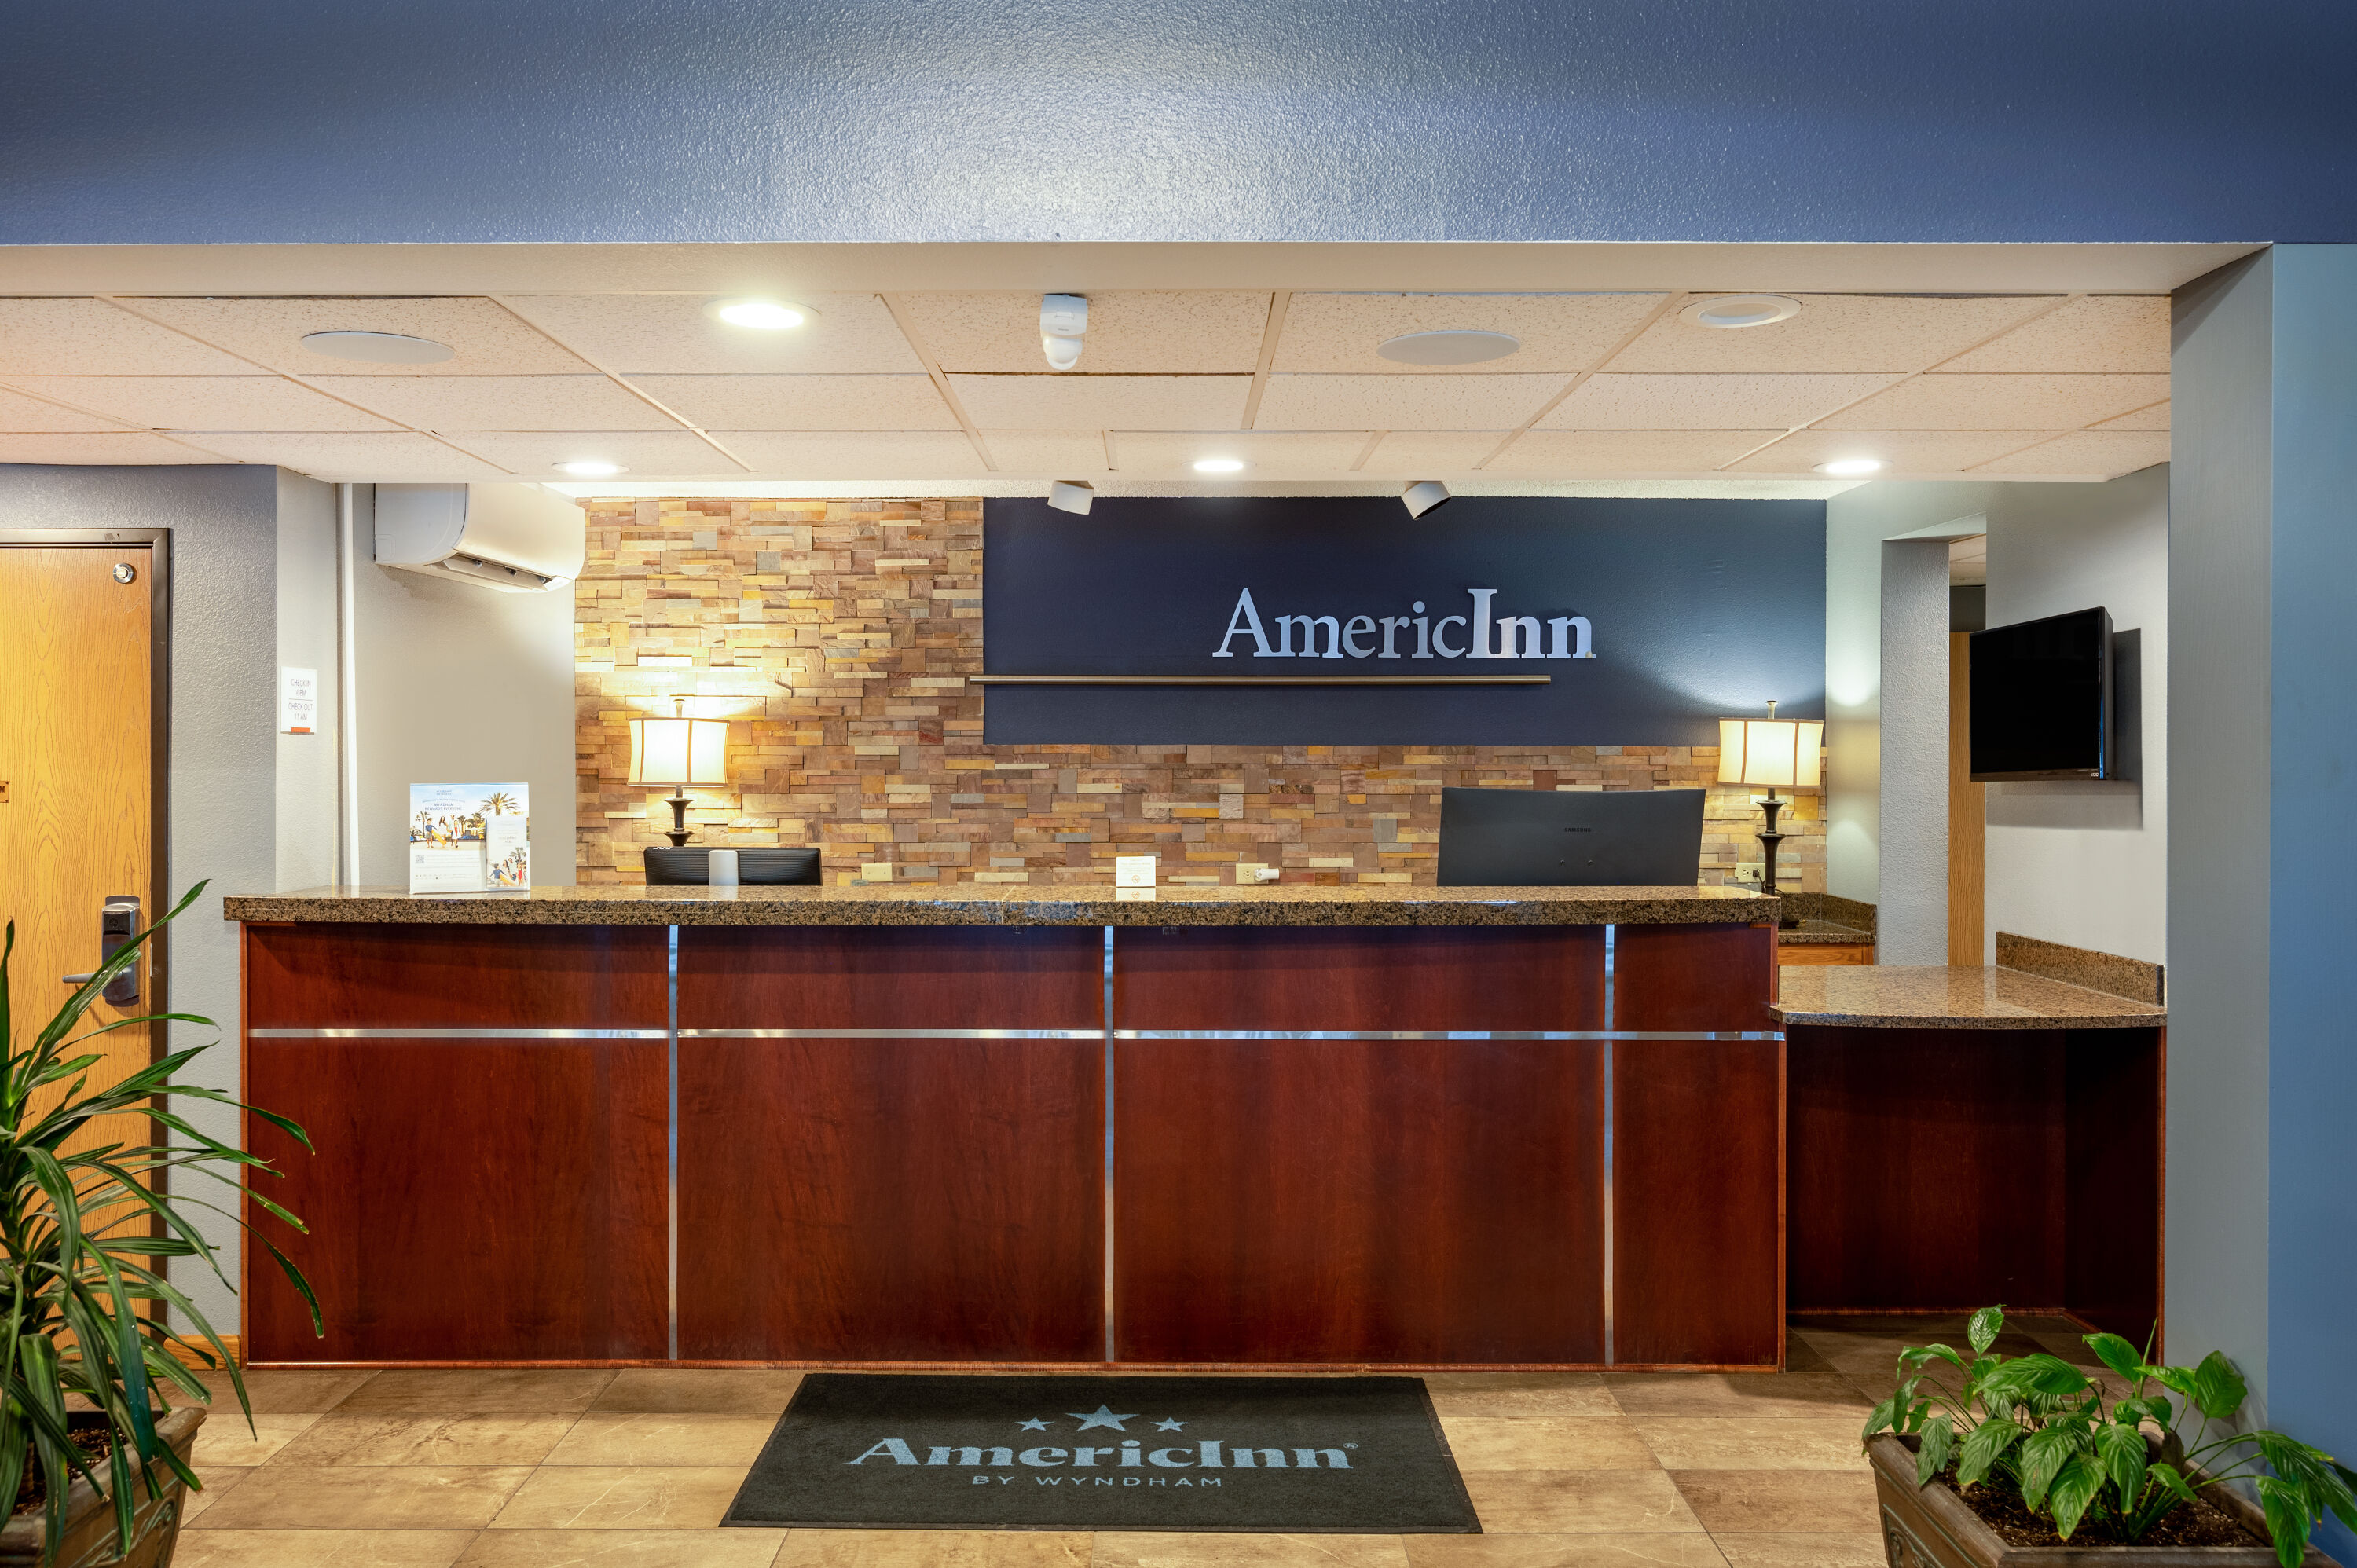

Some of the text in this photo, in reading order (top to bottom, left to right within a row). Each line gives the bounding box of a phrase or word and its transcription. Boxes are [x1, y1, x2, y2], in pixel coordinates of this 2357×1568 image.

[1212, 588, 1596, 658] AmericInn
[288, 702, 303, 711] CHECK
[972, 1475, 1222, 1487] BY WYNDHAM
